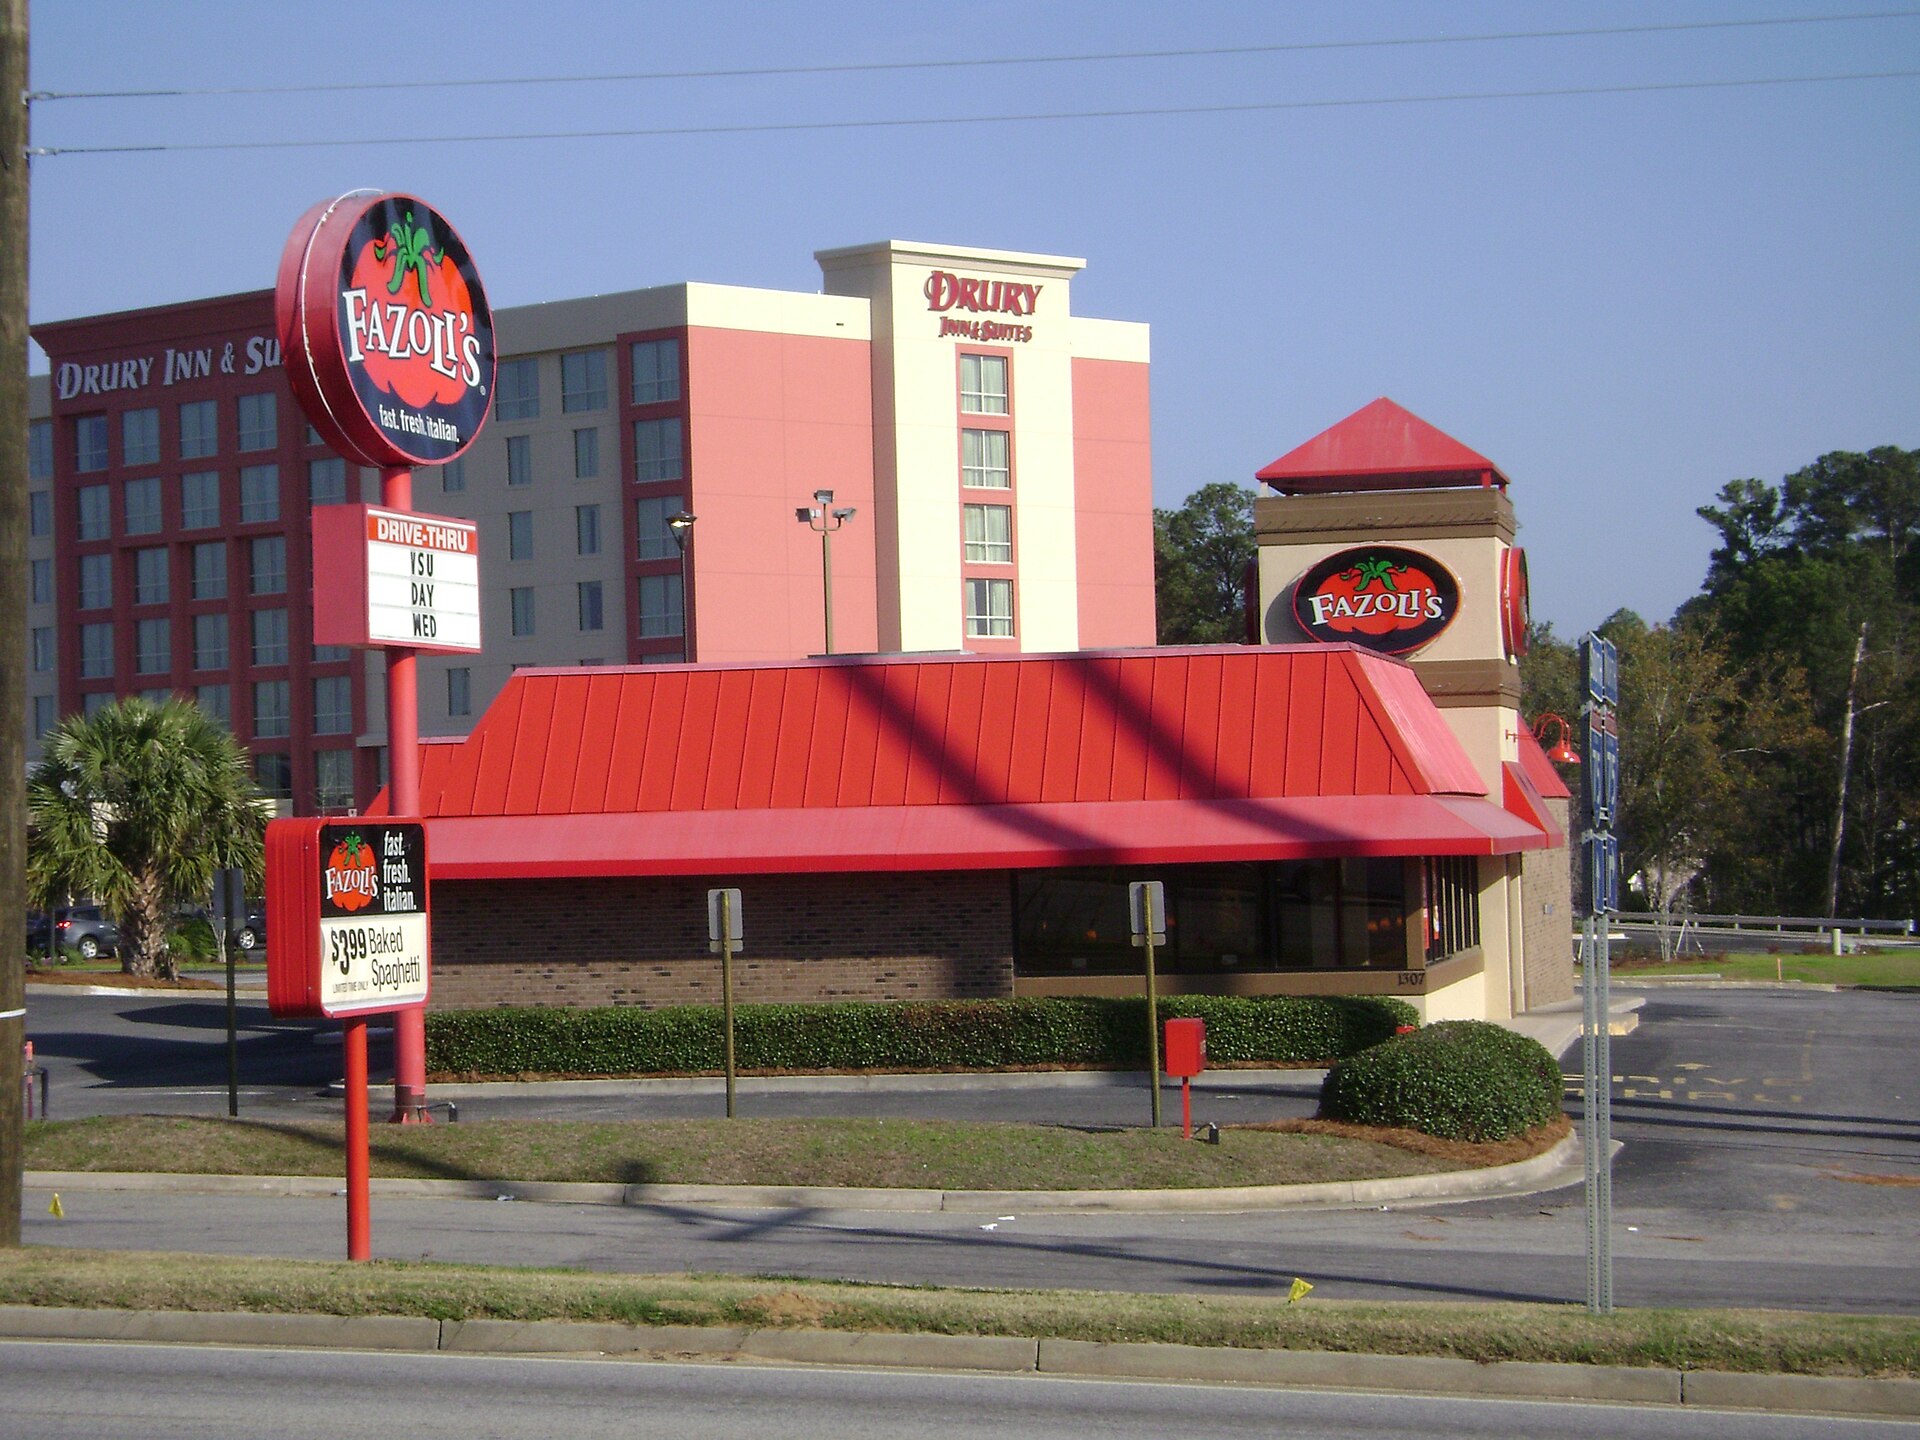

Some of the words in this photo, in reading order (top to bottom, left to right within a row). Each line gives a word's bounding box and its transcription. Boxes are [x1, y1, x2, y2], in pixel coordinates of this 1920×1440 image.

[923, 270, 1043, 316] DRURY
[342, 288, 481, 388] FAZOLI'S
[938, 316, 971, 337] INN
[980, 320, 1033, 343] SUITES
[57, 358, 153, 400] DRURY
[163, 349, 211, 386] INN
[221, 342, 235, 374] &
[245, 336, 284, 375] SU
[379, 404, 400, 430] fast.
[400, 409, 428, 436] fresh.
[425, 415, 460, 443] italian.
[377, 517, 468, 552] DRIVE-THRU
[410, 551, 434, 577] VSU
[411, 582, 434, 608] DAY
[1308, 588, 1443, 626] FAZOLI'S
[412, 613, 437, 638] WED
[383, 831, 405, 856] fast.
[325, 866, 379, 900] FAZOLI'S
[383, 858, 411, 884] fresh.
[383, 886, 417, 912] italian.
[368, 925, 403, 954] Baked
[371, 955, 421, 992] Spaghetti
[1398, 972, 1425, 986] 1307
